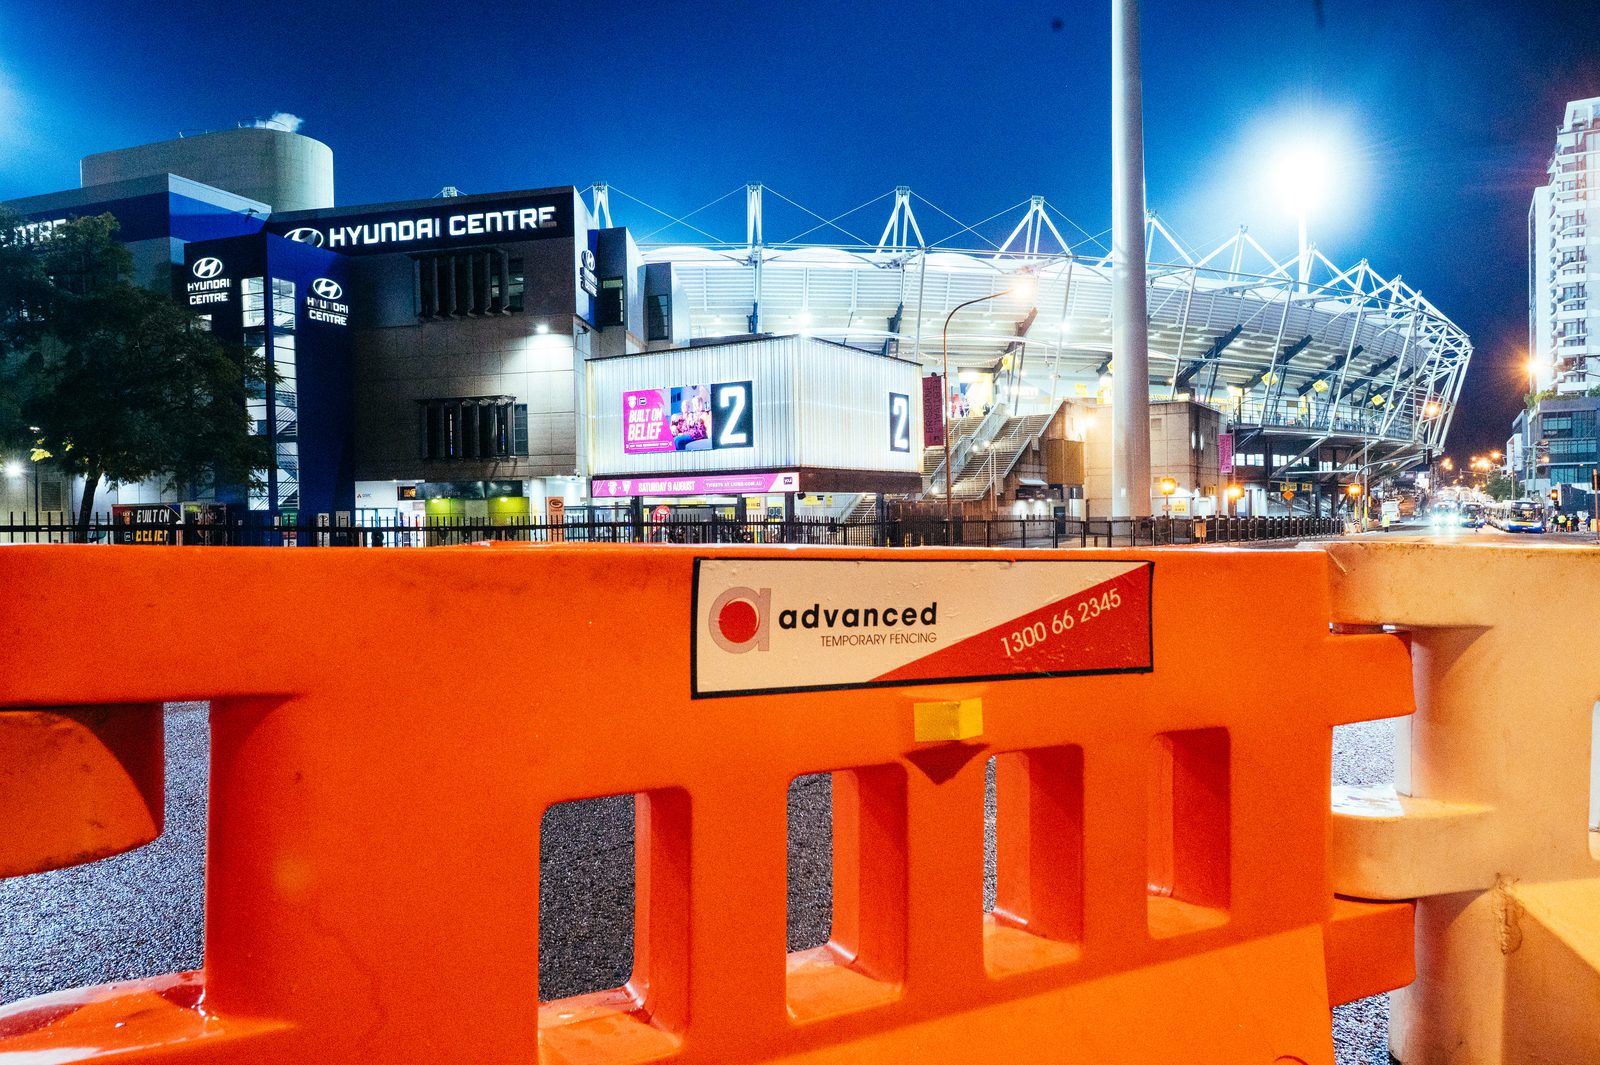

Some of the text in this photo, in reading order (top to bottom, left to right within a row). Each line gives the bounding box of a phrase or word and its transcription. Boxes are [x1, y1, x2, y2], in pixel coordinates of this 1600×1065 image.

[329, 206, 557, 247] HYUNDAI CENTRE
[187, 278, 231, 292] HYUNDAI
[189, 292, 229, 305] CENTRE
[306, 297, 349, 314] HYUNDAI
[309, 309, 348, 326] CENTRE
[629, 407, 663, 423] BUILT ON
[719, 386, 747, 445] 2
[893, 396, 908, 449] 2
[627, 422, 663, 441] BELIEF
[638, 479, 696, 493] SATURDAY 9 AUGUST
[779, 602, 937, 631] advanced
[999, 588, 1122, 658] 1300 66 2345
[821, 632, 937, 648] TEMPORARY FENCING
